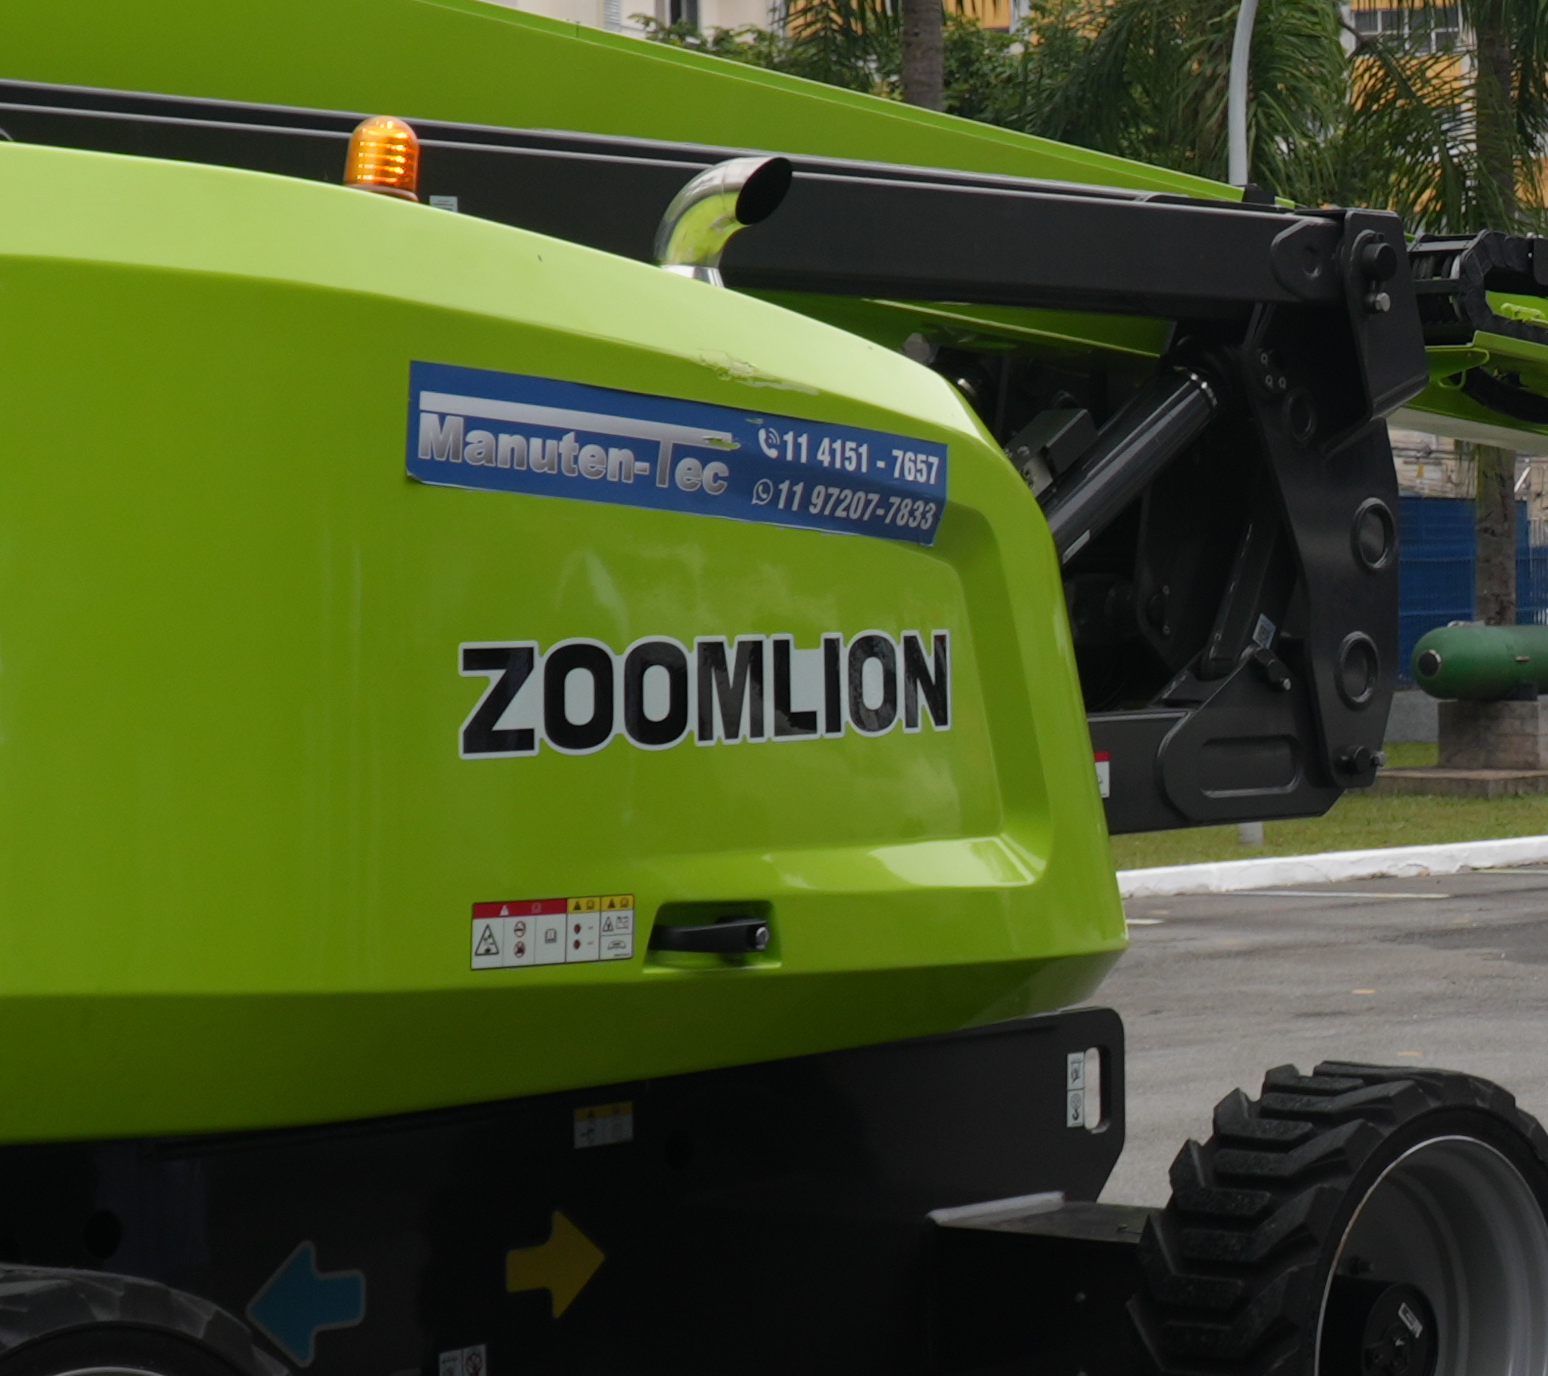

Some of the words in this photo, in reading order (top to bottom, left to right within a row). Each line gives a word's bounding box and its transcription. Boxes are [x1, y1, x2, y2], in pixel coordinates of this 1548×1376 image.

[418, 390, 740, 496] Manuten-Tec
[782, 431, 809, 463] 11
[816, 436, 870, 474] 4151
[892, 449, 940, 486] 7657
[776, 480, 803, 513] 11
[809, 485, 937, 531] 97207-7833
[460, 630, 950, 758] ZOOMLION
